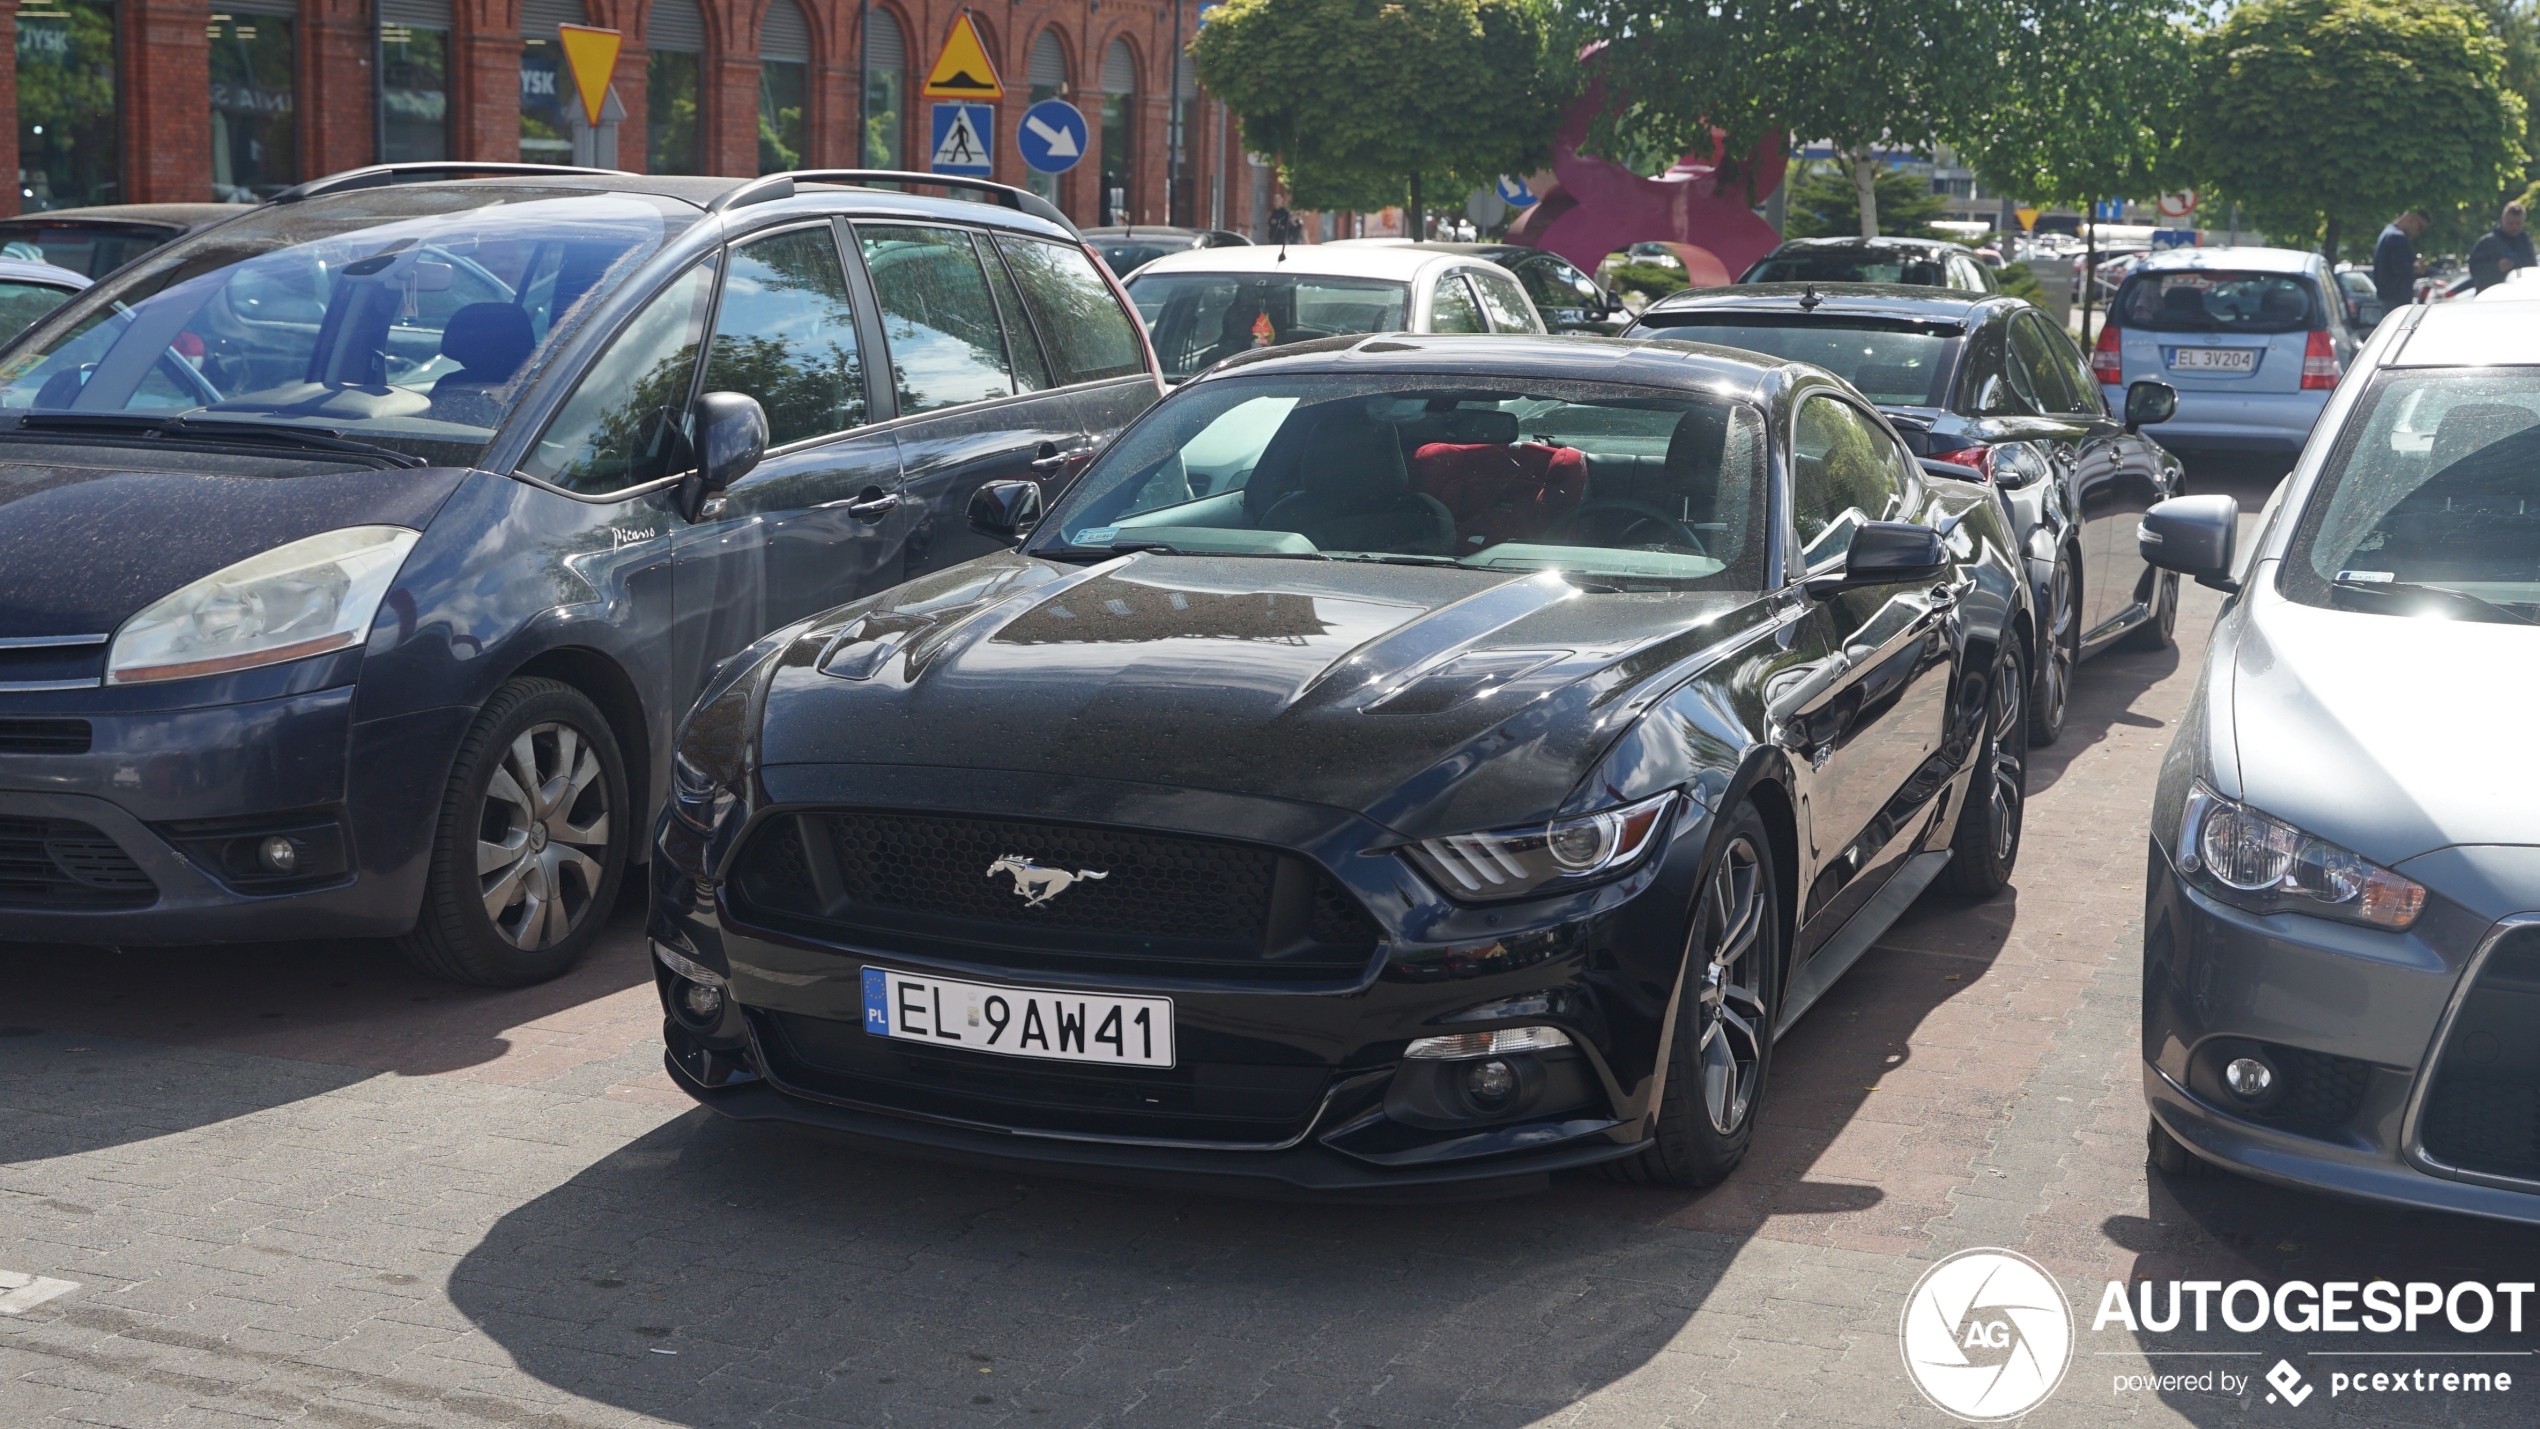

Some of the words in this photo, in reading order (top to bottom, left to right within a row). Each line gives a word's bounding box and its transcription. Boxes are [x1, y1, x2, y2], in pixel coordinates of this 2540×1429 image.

[22, 29, 69, 51] JYSK
[520, 70, 555, 94] YSK
[2178, 351, 2197, 366] EL
[2204, 351, 2251, 367] 3V204
[611, 526, 656, 555] Picasso
[868, 1008, 886, 1025] PL
[897, 980, 962, 1041] EL
[984, 994, 1152, 1059] 9AW41
